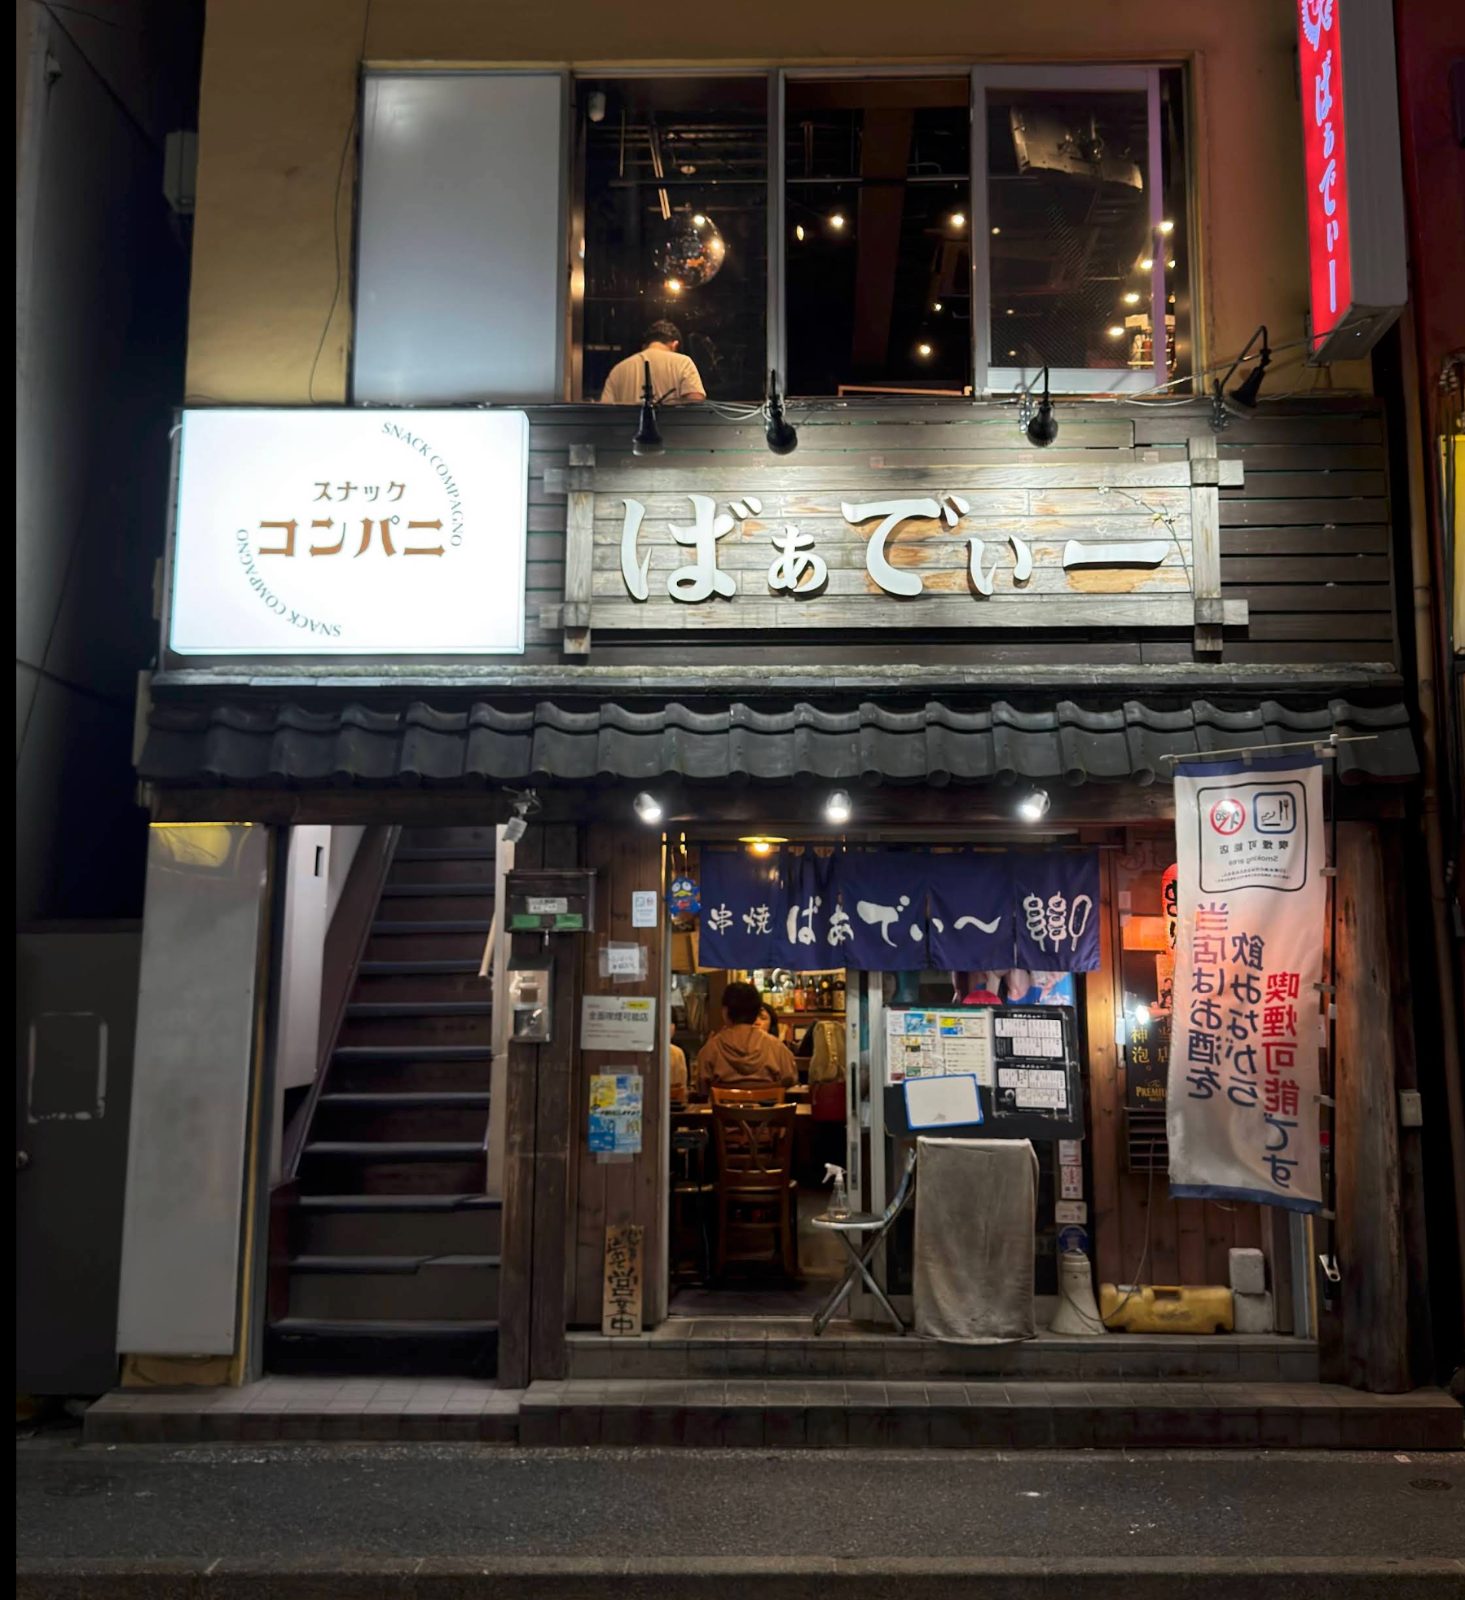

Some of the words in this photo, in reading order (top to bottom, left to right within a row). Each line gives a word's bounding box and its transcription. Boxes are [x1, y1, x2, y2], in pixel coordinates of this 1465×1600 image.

[312, 480, 407, 502] スナック
[381, 421, 432, 457] SNACK
[430, 454, 464, 548] COMPAGNO
[258, 515, 446, 559] コンパニ
[621, 493, 1170, 603] ばぁでぃー
[235, 528, 287, 616] COMPAGNO
[289, 609, 342, 638] SNACK
[707, 903, 774, 935] 串焼
